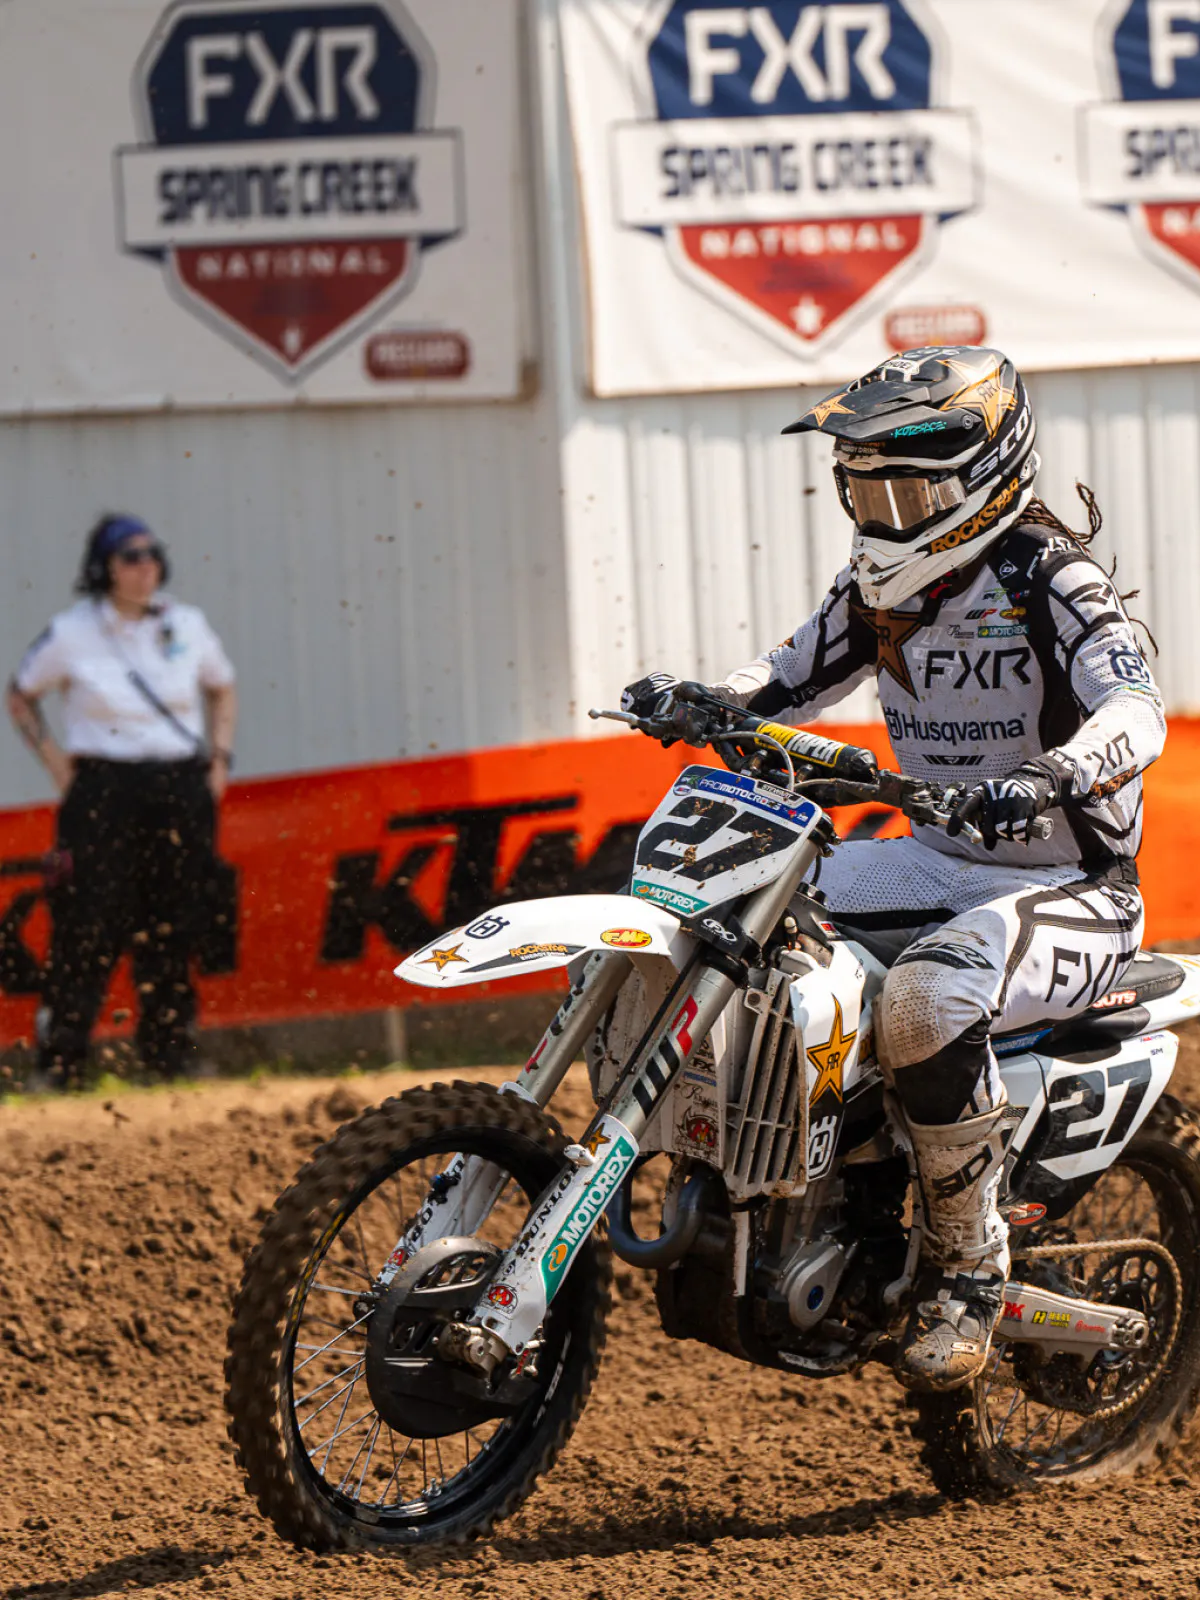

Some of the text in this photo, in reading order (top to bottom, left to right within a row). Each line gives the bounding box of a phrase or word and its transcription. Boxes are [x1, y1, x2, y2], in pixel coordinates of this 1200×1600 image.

[185, 26, 379, 128] FXR
[685, 4, 896, 104] FXR
[157, 155, 420, 226] SPRING CREEK
[661, 135, 934, 197] SPRING CREEK
[197, 247, 390, 282] NATIONAL
[700, 222, 906, 259] NATIONAL
[925, 647, 1032, 689] FXR
[903, 714, 1026, 746] Husqvarna
[636, 796, 800, 881] 27
[650, 886, 699, 909] MOTOREX
[509, 943, 568, 957] ROCKSTAR
[604, 931, 650, 944] FMF
[1039, 1058, 1152, 1162] 27
[562, 1148, 631, 1246] MOTOREX
